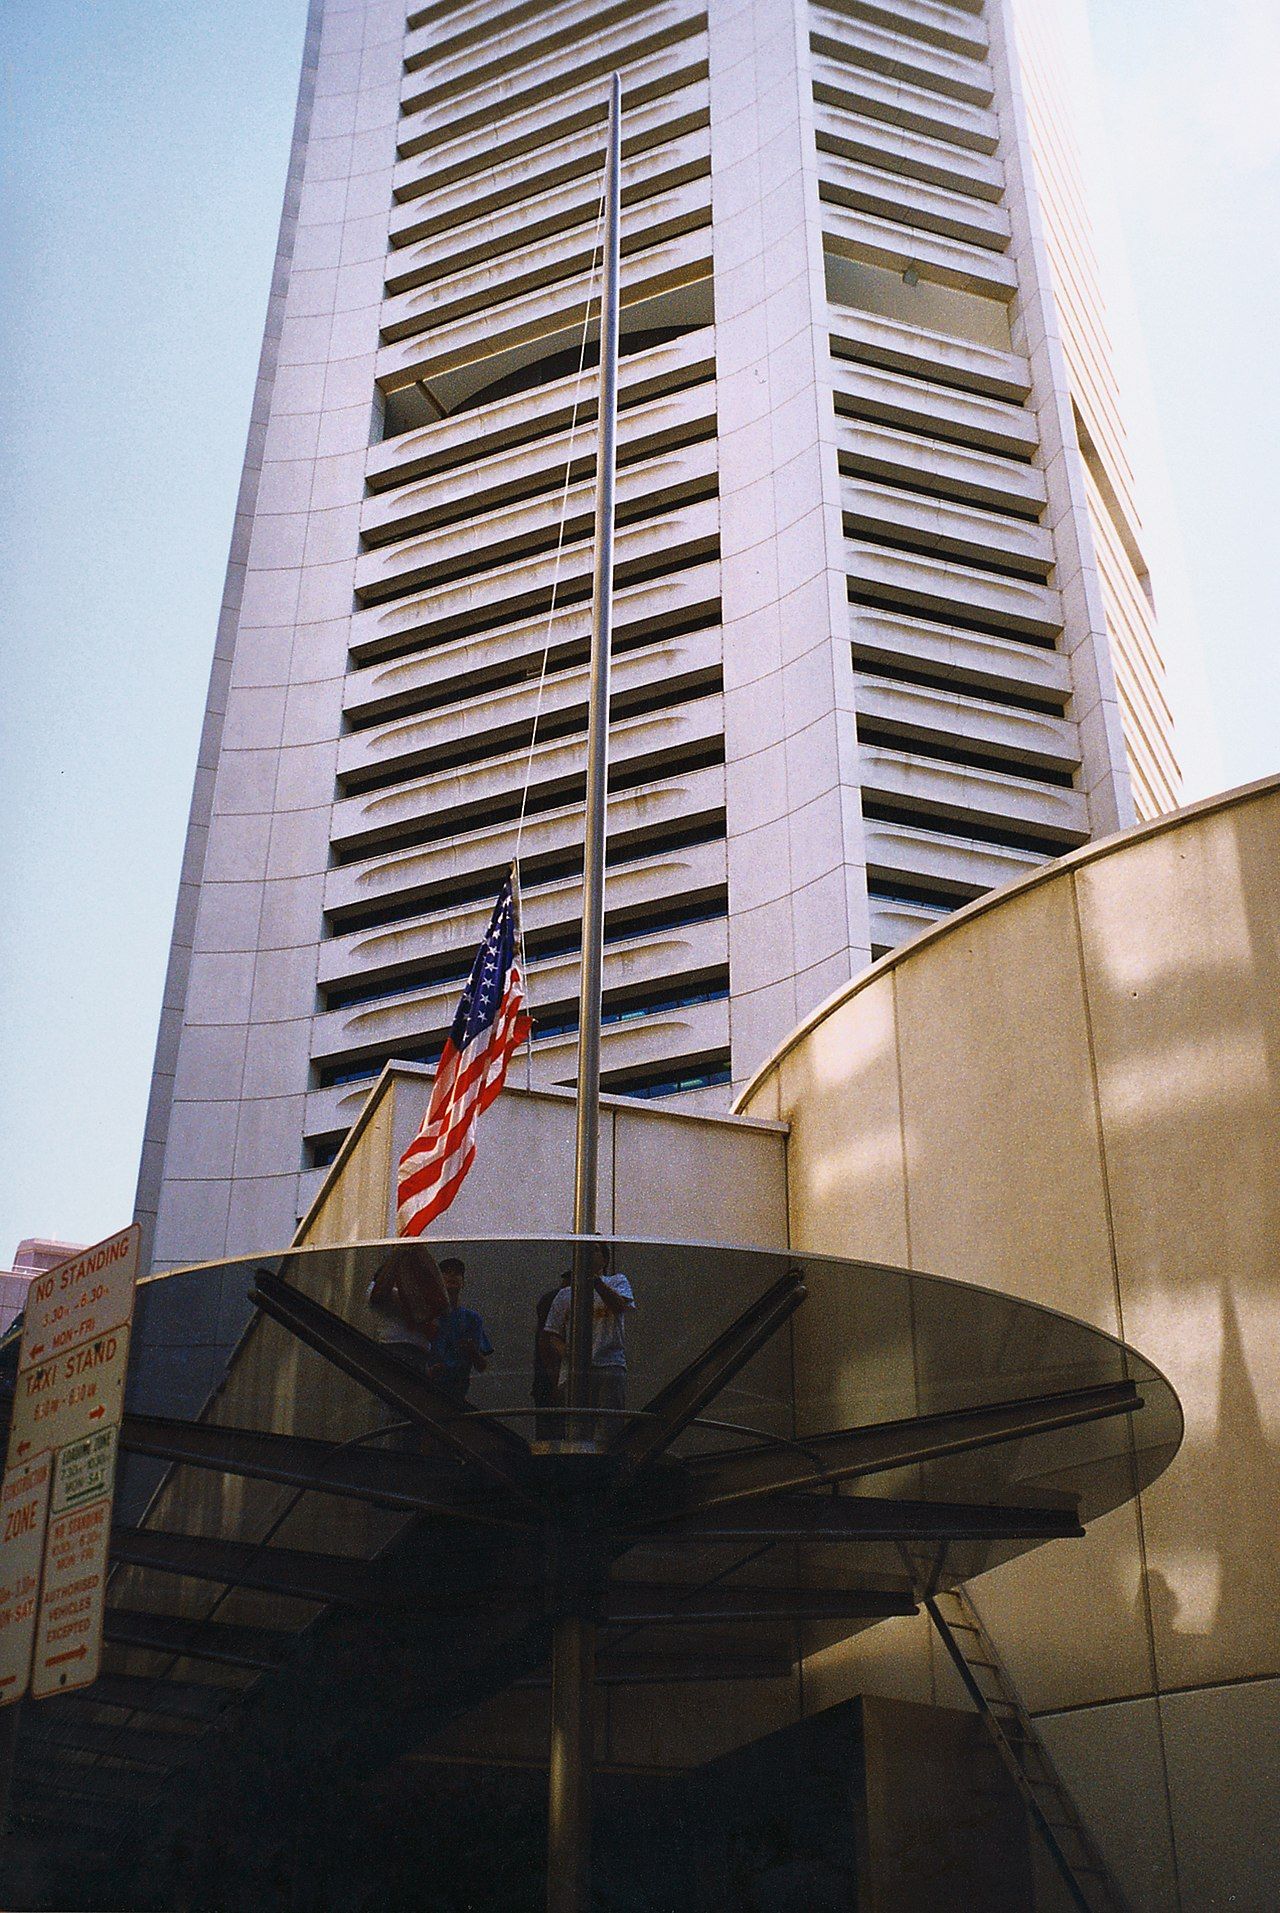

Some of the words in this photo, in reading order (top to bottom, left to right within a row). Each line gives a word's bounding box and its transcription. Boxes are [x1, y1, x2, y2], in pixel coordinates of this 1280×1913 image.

[36, 1278, 54, 1303] NO
[60, 1237, 130, 1290] STANDING
[26, 1365, 57, 1397] TAXI
[65, 1338, 117, 1379] STAND
[4, 1500, 38, 1542] ZONE
[43, 1574, 99, 1603] AUTHORISED
[49, 1597, 91, 1621] VEHICLES
[46, 1617, 91, 1643] EXCEPTED
